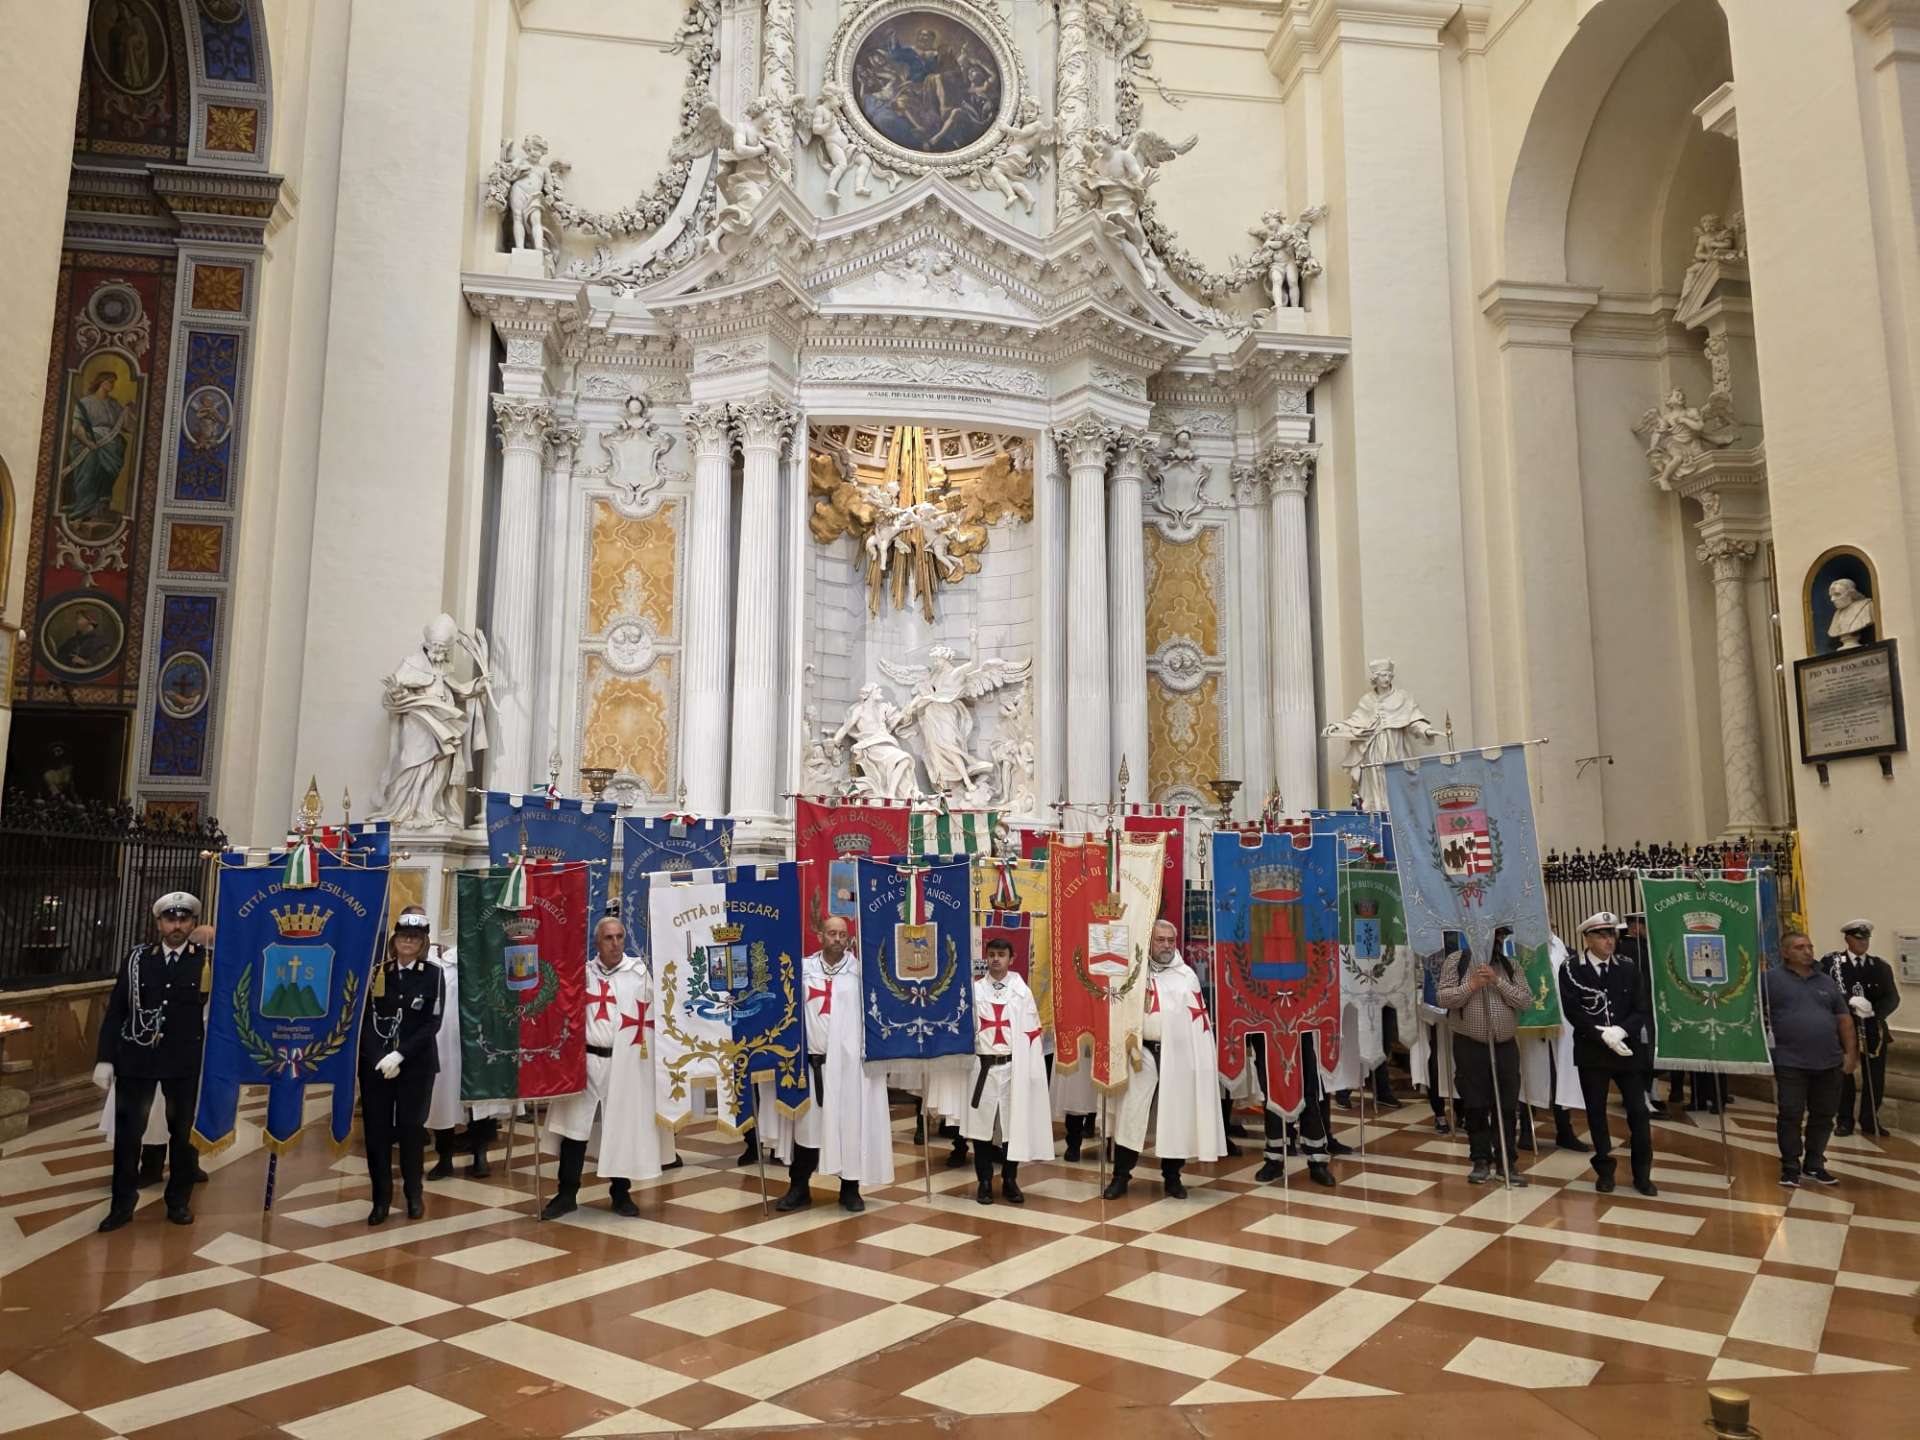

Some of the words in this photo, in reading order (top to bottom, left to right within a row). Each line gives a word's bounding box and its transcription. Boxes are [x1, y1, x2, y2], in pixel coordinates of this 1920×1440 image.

[627, 846, 655, 880] COMUNE
[1090, 865, 1101, 877] DI
[932, 873, 942, 884] DI
[268, 882, 281, 895] DI
[710, 904, 720, 916] DI
[723, 900, 780, 921] PESCARA
[1654, 891, 1694, 912] COMUNE
[1708, 891, 1749, 915] SCANNO
